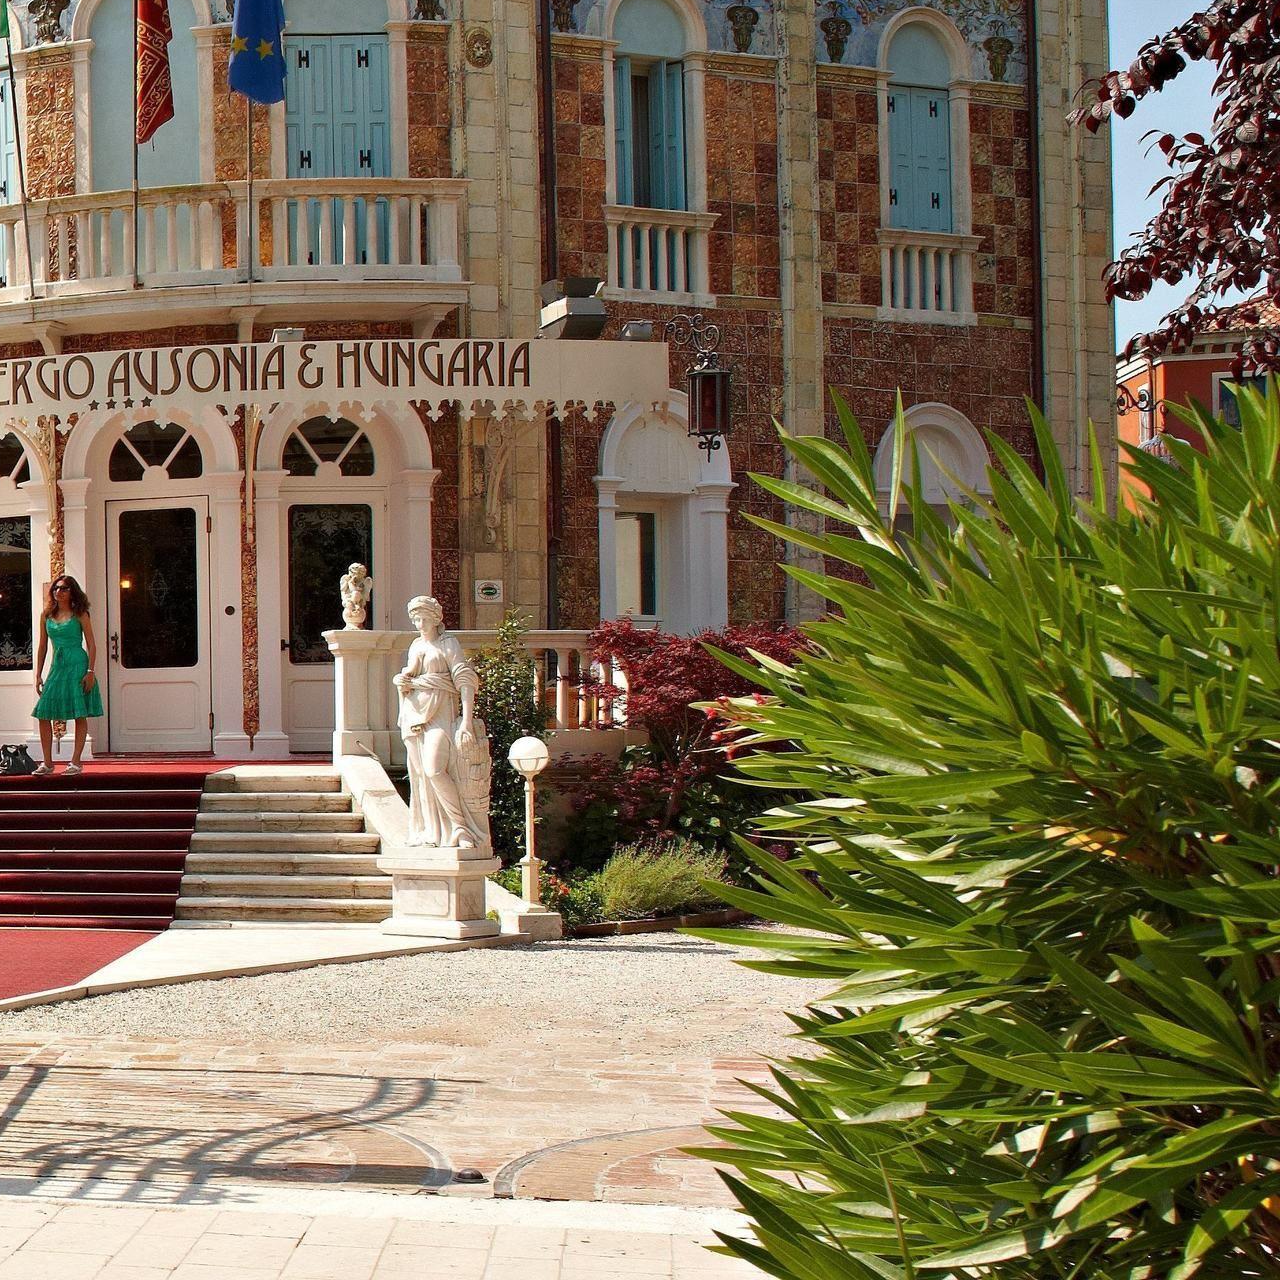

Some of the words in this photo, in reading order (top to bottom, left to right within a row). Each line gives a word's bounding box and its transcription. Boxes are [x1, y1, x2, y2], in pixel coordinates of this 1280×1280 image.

[107, 344, 285, 398] AUSONIA
[297, 343, 324, 389] &
[336, 341, 530, 388] HUNGARIA
